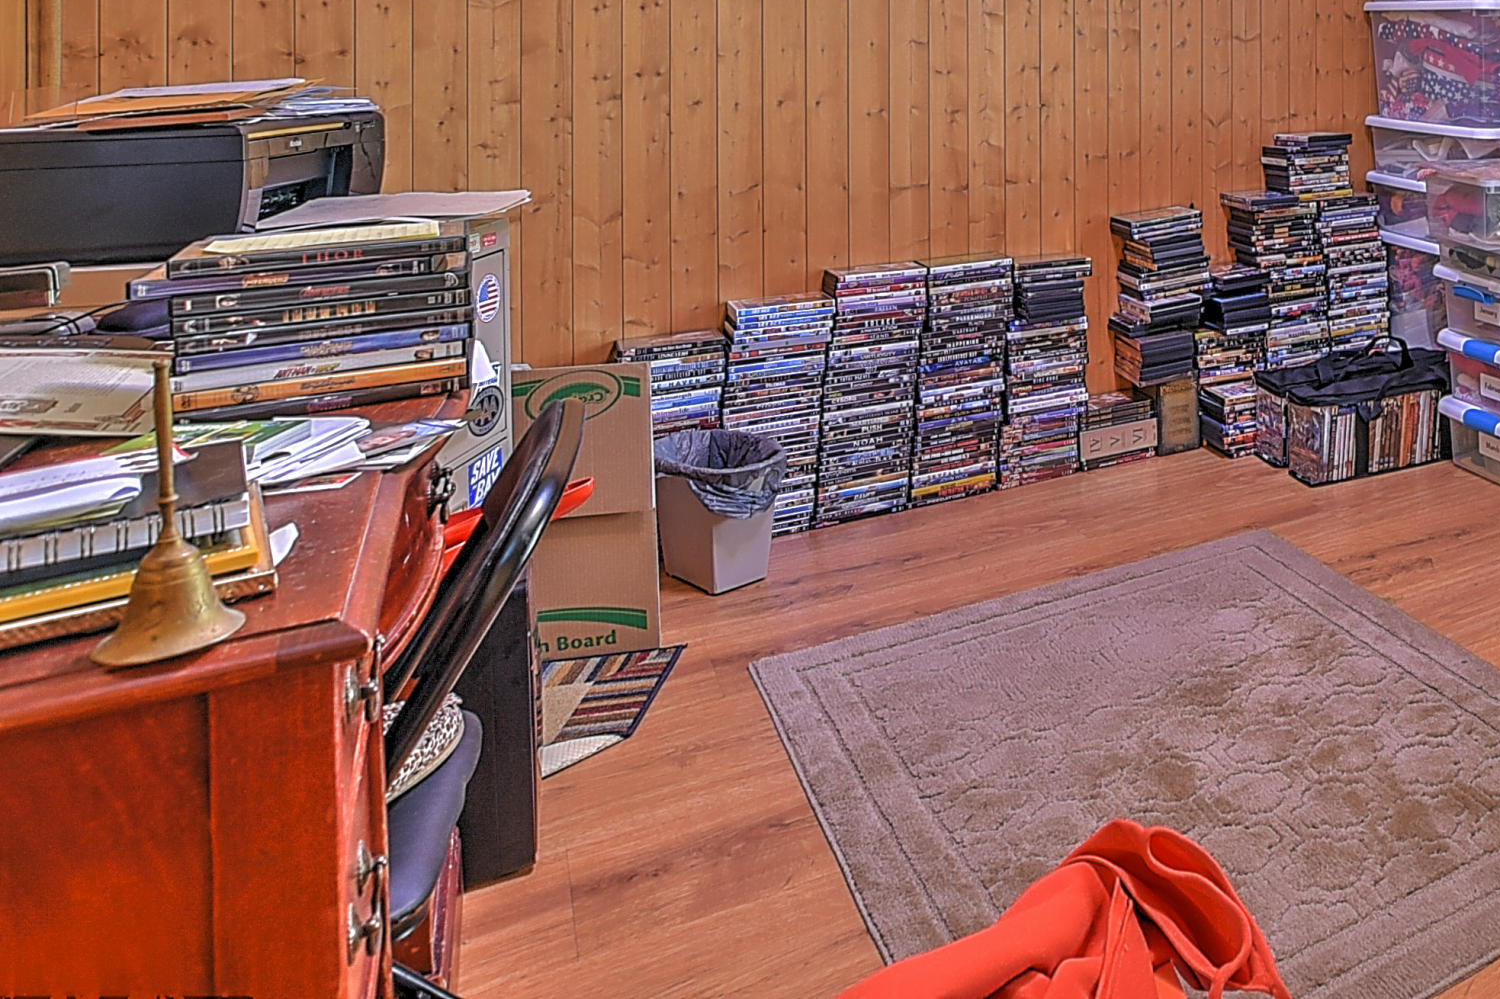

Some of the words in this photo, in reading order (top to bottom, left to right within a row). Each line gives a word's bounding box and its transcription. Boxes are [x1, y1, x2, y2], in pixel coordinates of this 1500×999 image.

[954, 357, 982, 367] AVATAR
[861, 424, 882, 433] PUSH
[853, 437, 883, 447] NOAH
[471, 446, 501, 485] SAVE
[556, 629, 617, 651] Board
